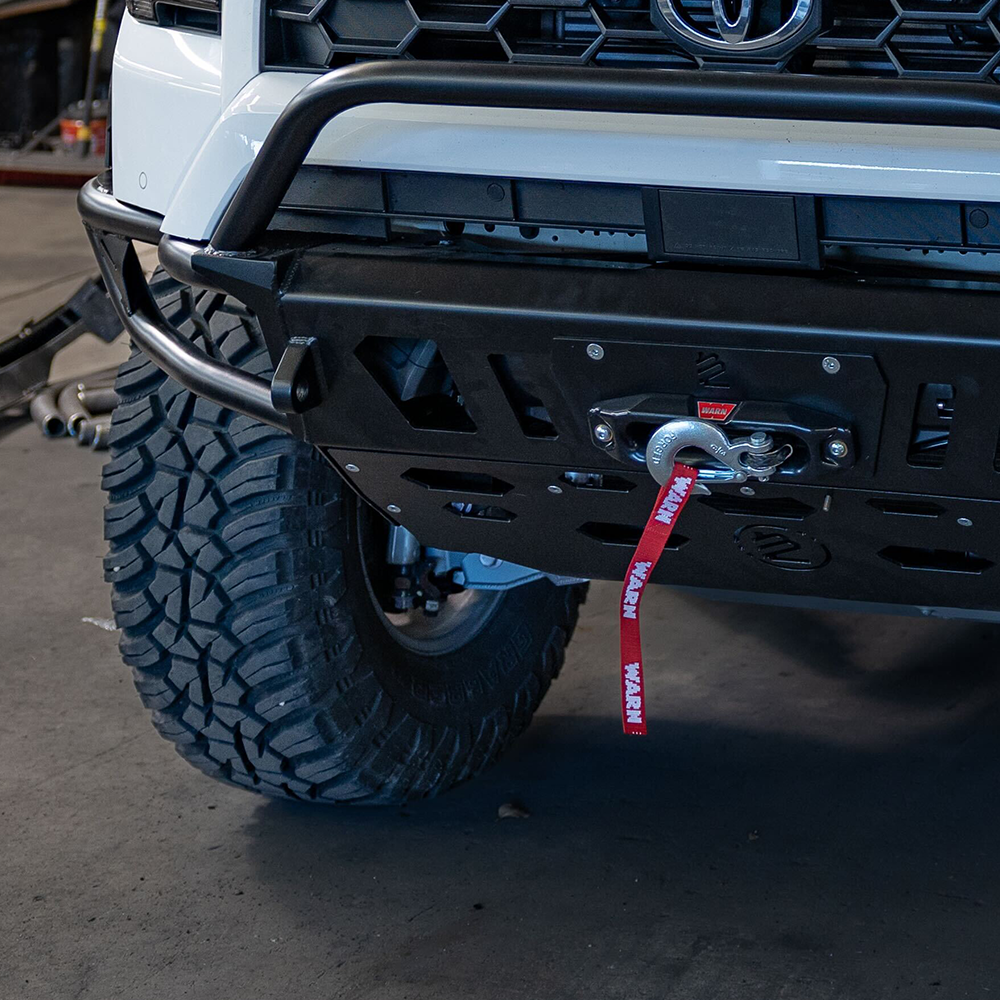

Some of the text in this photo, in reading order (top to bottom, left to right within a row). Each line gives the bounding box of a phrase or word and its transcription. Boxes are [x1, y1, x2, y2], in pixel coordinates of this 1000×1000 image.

[701, 407, 727, 415] WARN
[655, 476, 692, 525] WARN
[623, 561, 652, 620] WARN
[624, 662, 643, 724] WARN
